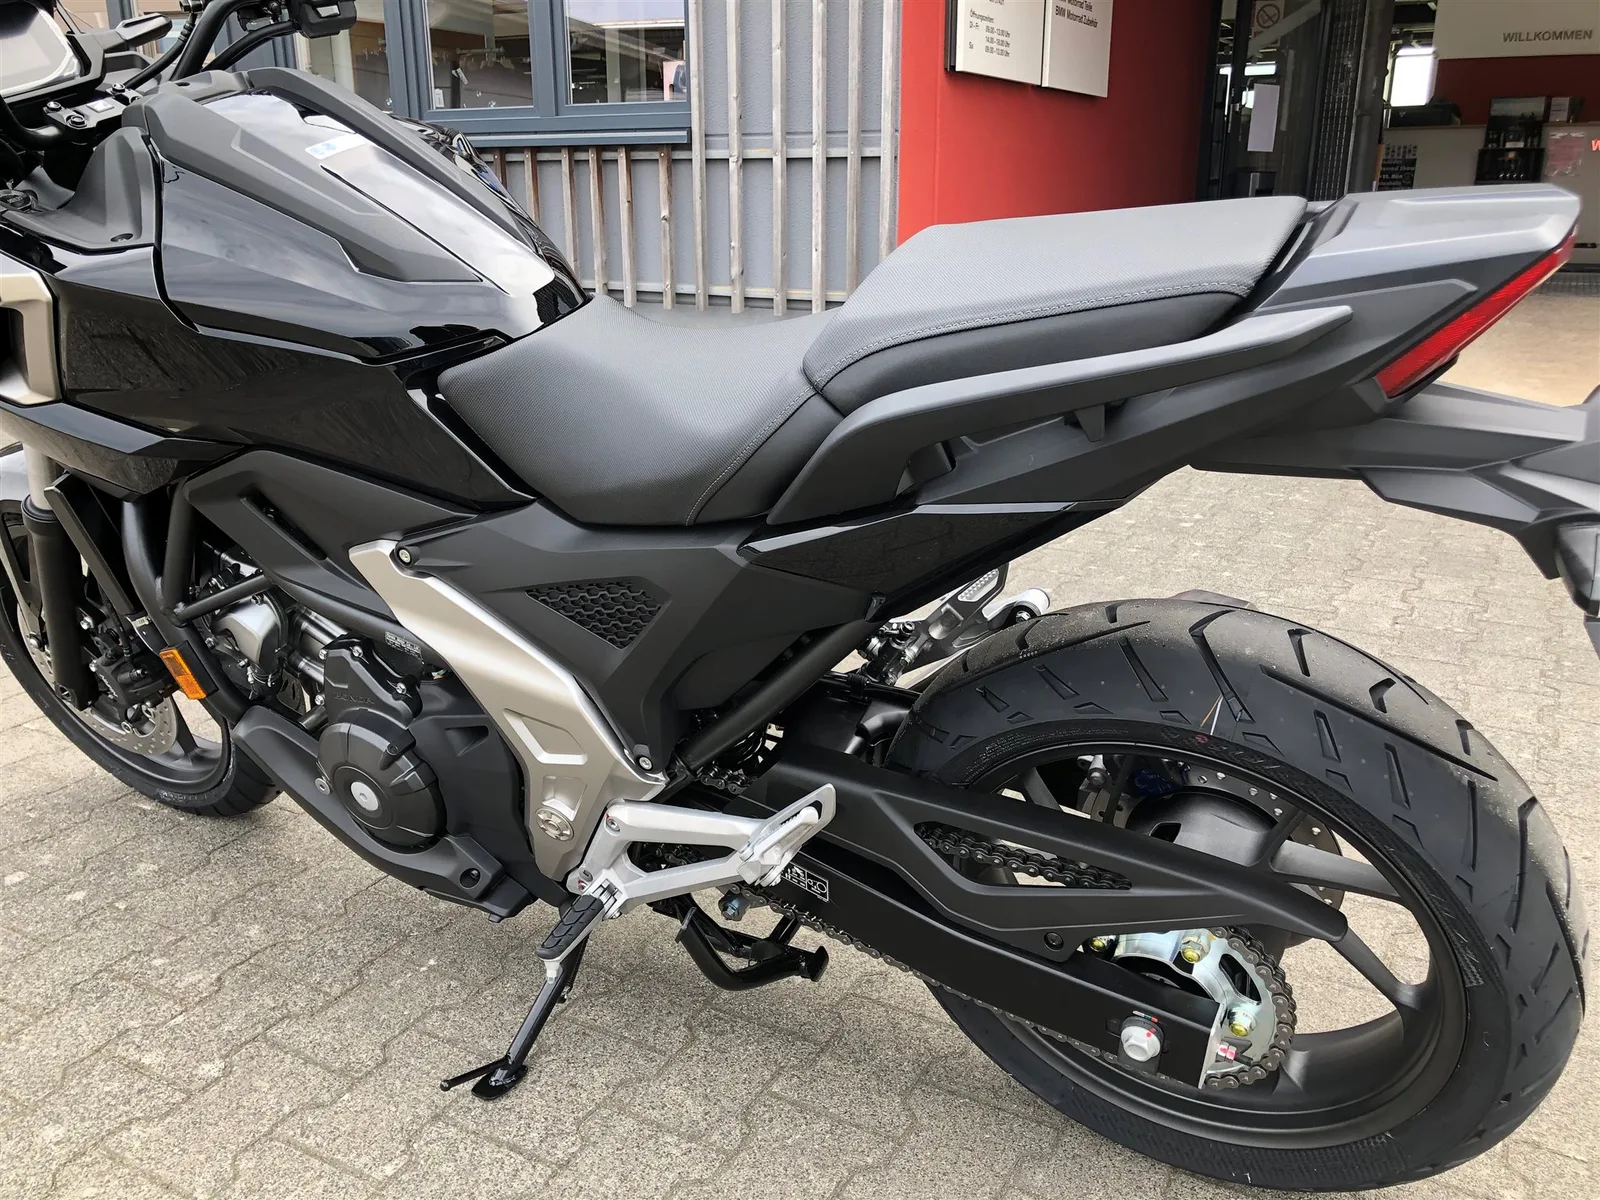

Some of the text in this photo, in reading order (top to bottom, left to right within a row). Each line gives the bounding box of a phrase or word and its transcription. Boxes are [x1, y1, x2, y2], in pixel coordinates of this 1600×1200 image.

[1056, 5, 1098, 28] BMW Motorrad Zubehör
[1502, 29, 1593, 42] WILLKOMMEN
